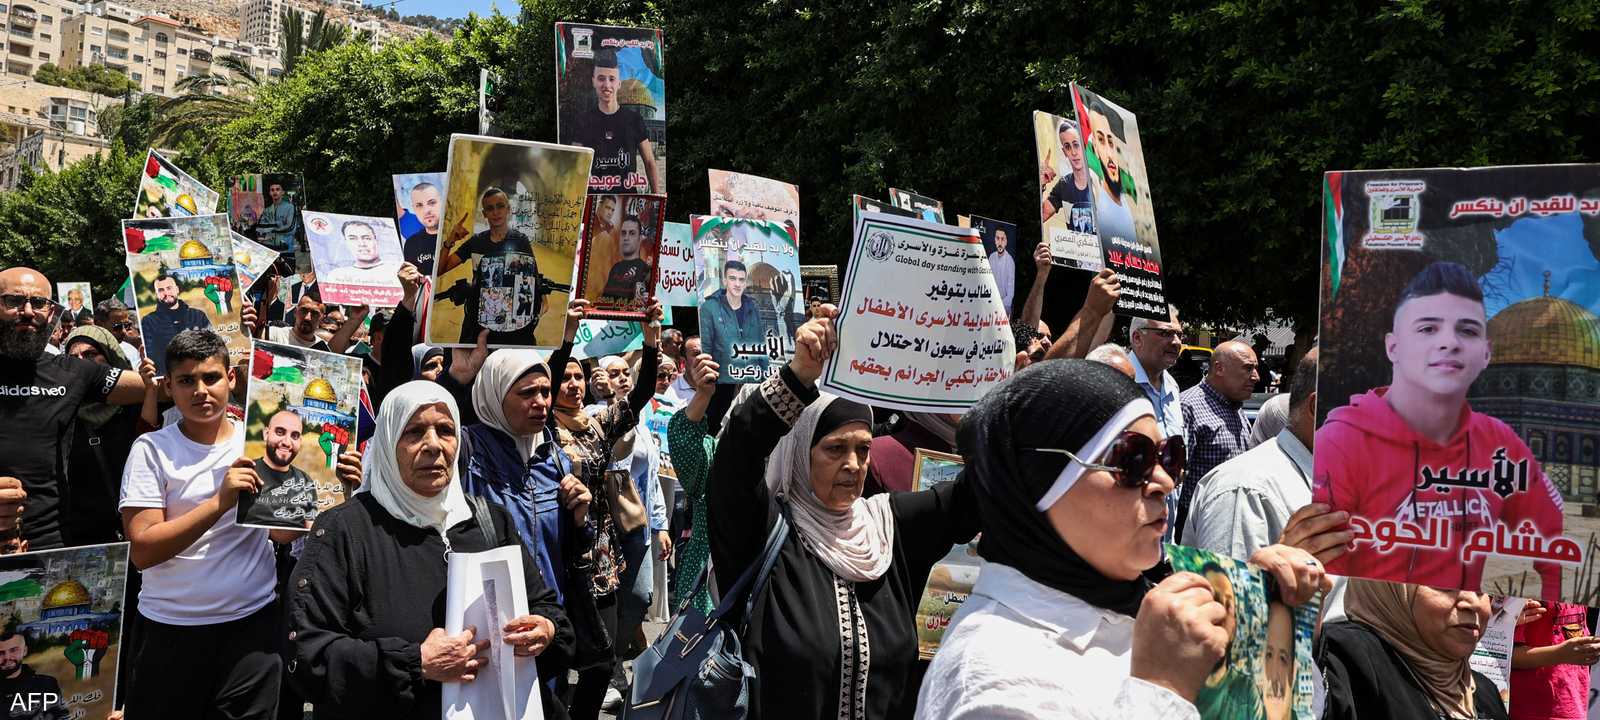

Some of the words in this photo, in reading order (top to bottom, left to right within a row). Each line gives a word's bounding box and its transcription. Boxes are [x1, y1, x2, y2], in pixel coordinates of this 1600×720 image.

[588, 175, 622, 190] عويج
[624, 171, 648, 189] جلال
[1449, 197, 1504, 218] ينكسر
[1508, 197, 1525, 215] ان
[1530, 195, 1575, 213] للقيد
[1580, 197, 1599, 215] بد
[783, 243, 794, 257] ولا
[897, 240, 937, 256] والأسرى
[895, 254, 921, 267] Global
[921, 260, 936, 271] day
[937, 264, 967, 276] standing
[662, 270, 685, 293] تخترق
[925, 280, 966, 303] بتوفير
[856, 297, 913, 321] الأطفال
[915, 310, 961, 330] للأسرى
[731, 329, 785, 360] الأسير
[870, 330, 930, 354] الاحتلال
[930, 342, 964, 359] سجون
[965, 340, 978, 362] في
[729, 365, 762, 380] زكريا
[850, 357, 892, 382] بحقهم
[894, 366, 944, 387] الجرائم
[945, 368, 982, 391] مرتكبي
[0, 384, 41, 396] didas
[1416, 447, 1529, 499] الأسير
[1395, 489, 1494, 526] METALLICA
[1462, 520, 1583, 564] هشام
